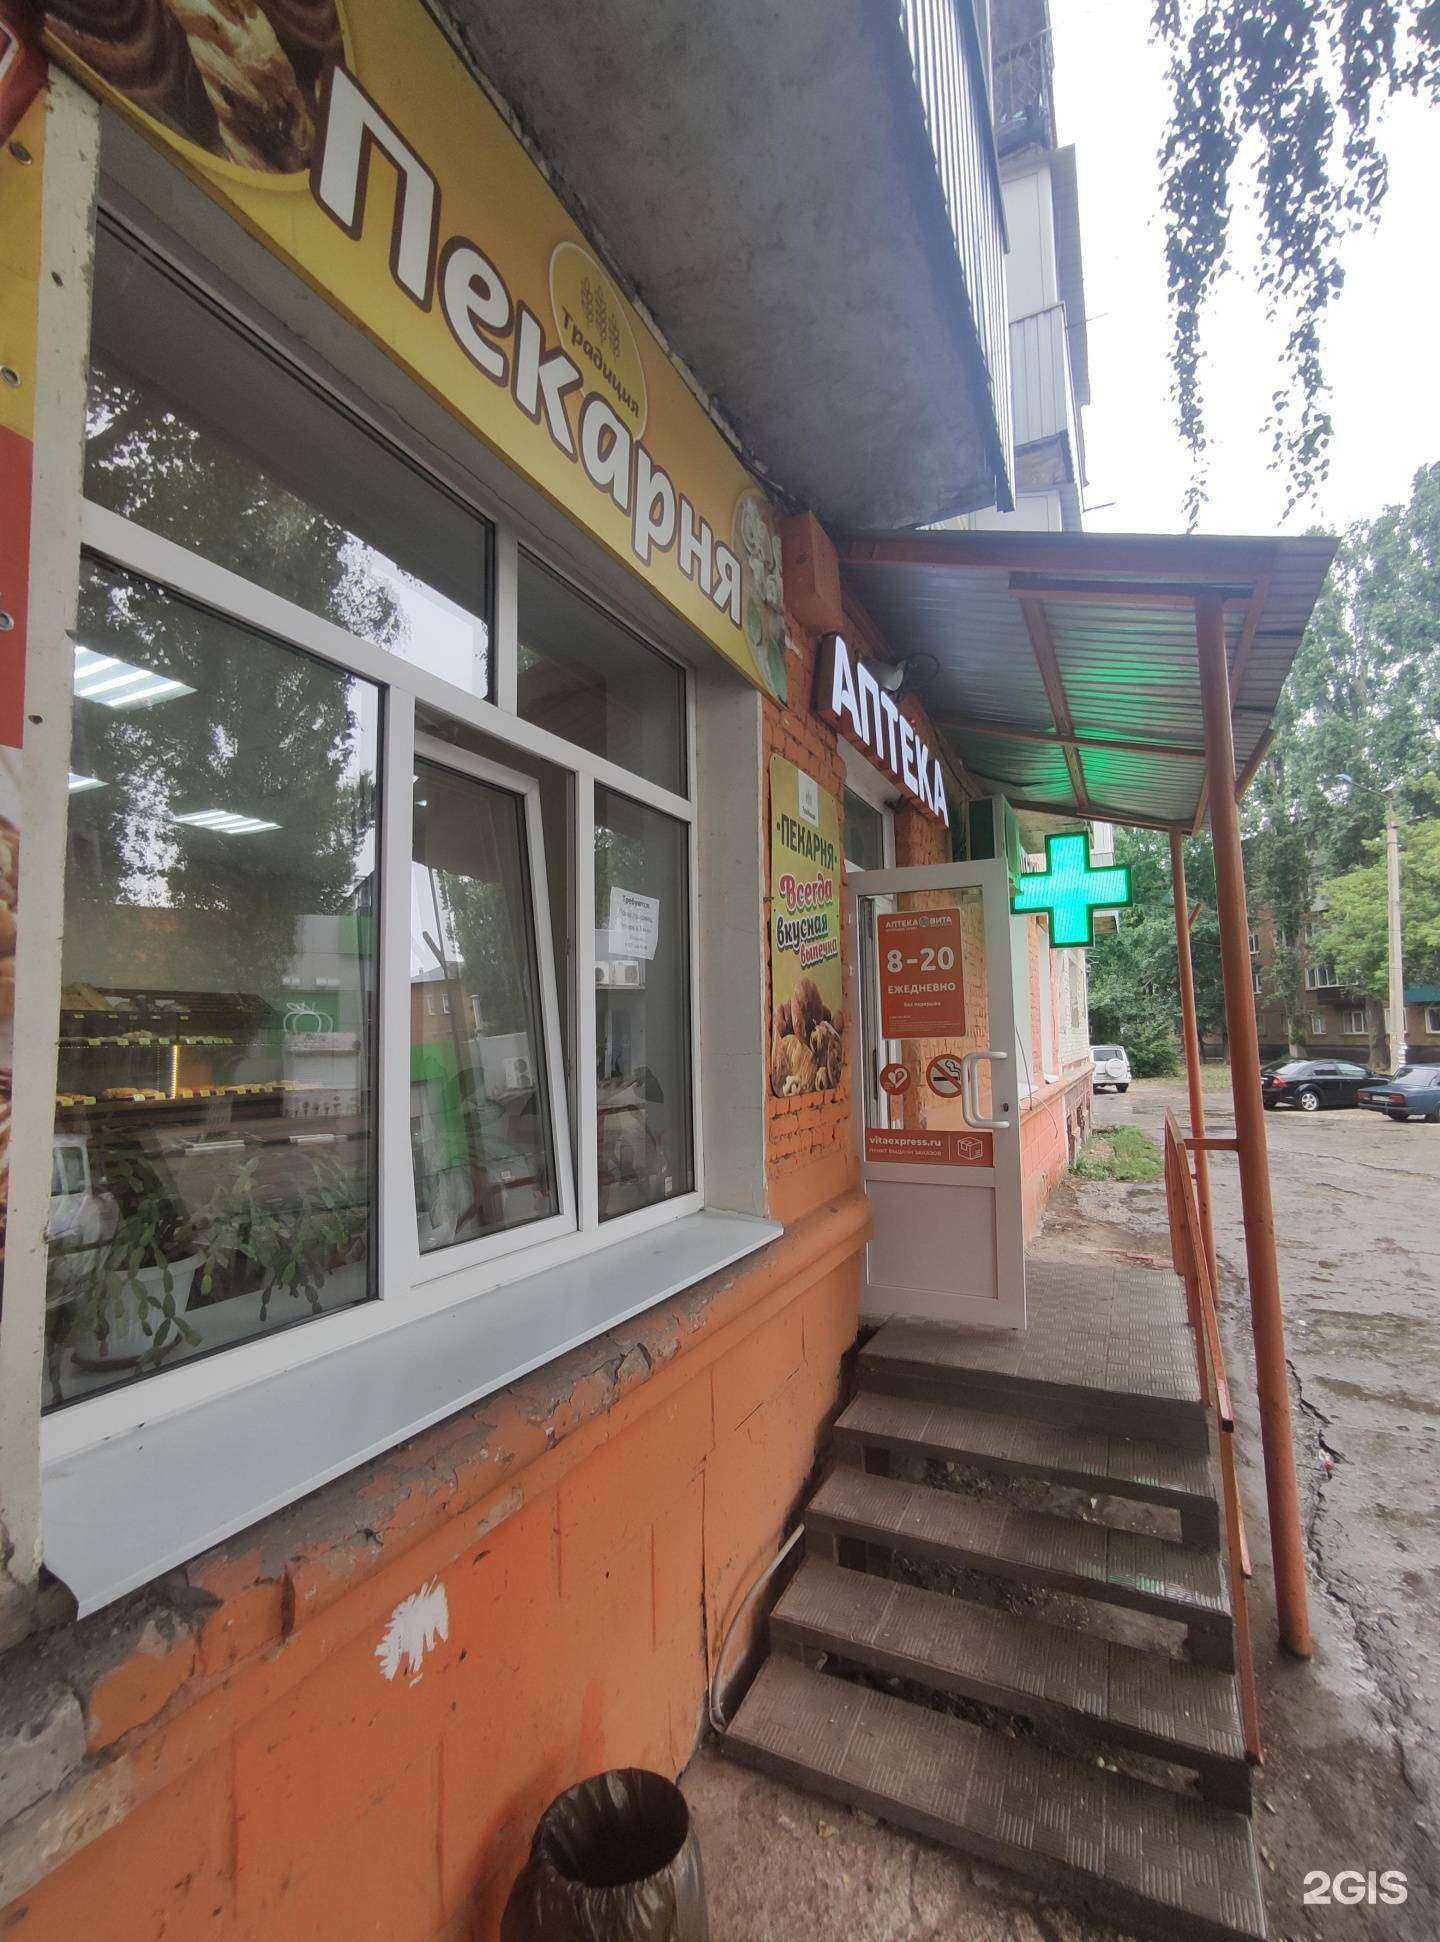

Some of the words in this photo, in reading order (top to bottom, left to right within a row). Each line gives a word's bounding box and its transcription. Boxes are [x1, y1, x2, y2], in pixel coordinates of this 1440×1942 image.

[318, 65, 744, 628] Пекарня
[561, 304, 640, 418] Традиция
[832, 635, 950, 828] АПТЕКА
[781, 812, 835, 872] ПЕКАРНЯ
[779, 872, 833, 911] Всегда
[886, 920, 918, 928] АПТЕКА
[930, 916, 952, 925] ВИТА
[887, 947, 955, 973] 8-20
[888, 982, 956, 994] ЕЖЕДНЕВНО
[869, 1135, 942, 1147] vitaexpress.ru
